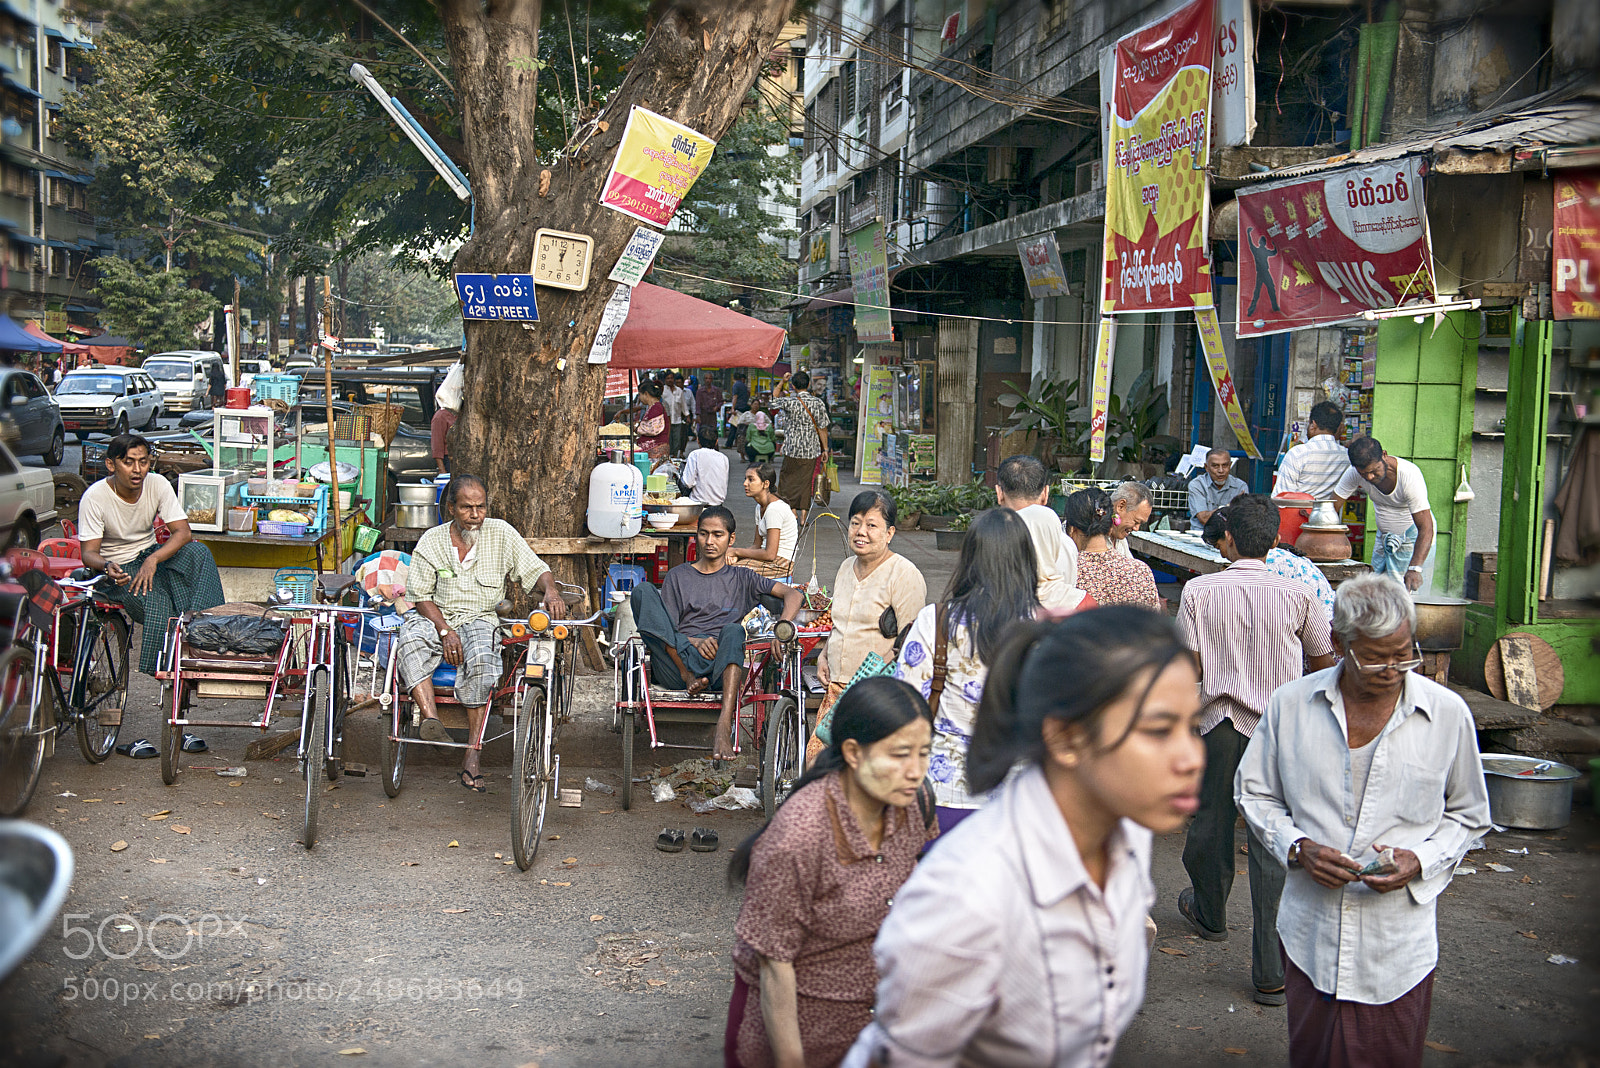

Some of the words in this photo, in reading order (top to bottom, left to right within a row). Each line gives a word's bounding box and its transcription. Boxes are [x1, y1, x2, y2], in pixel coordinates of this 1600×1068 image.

[608, 190, 620, 200] 09
[551, 239, 558, 247] 11
[560, 241, 568, 249] 12
[543, 244, 550, 252] 10
[576, 249, 582, 257] 2
[556, 272, 562, 280] 6
[565, 273, 571, 281] 5
[493, 277, 528, 298] လမ်း
[1317, 259, 1395, 308] PLUS
[1267, 383, 1276, 416] PUSH
